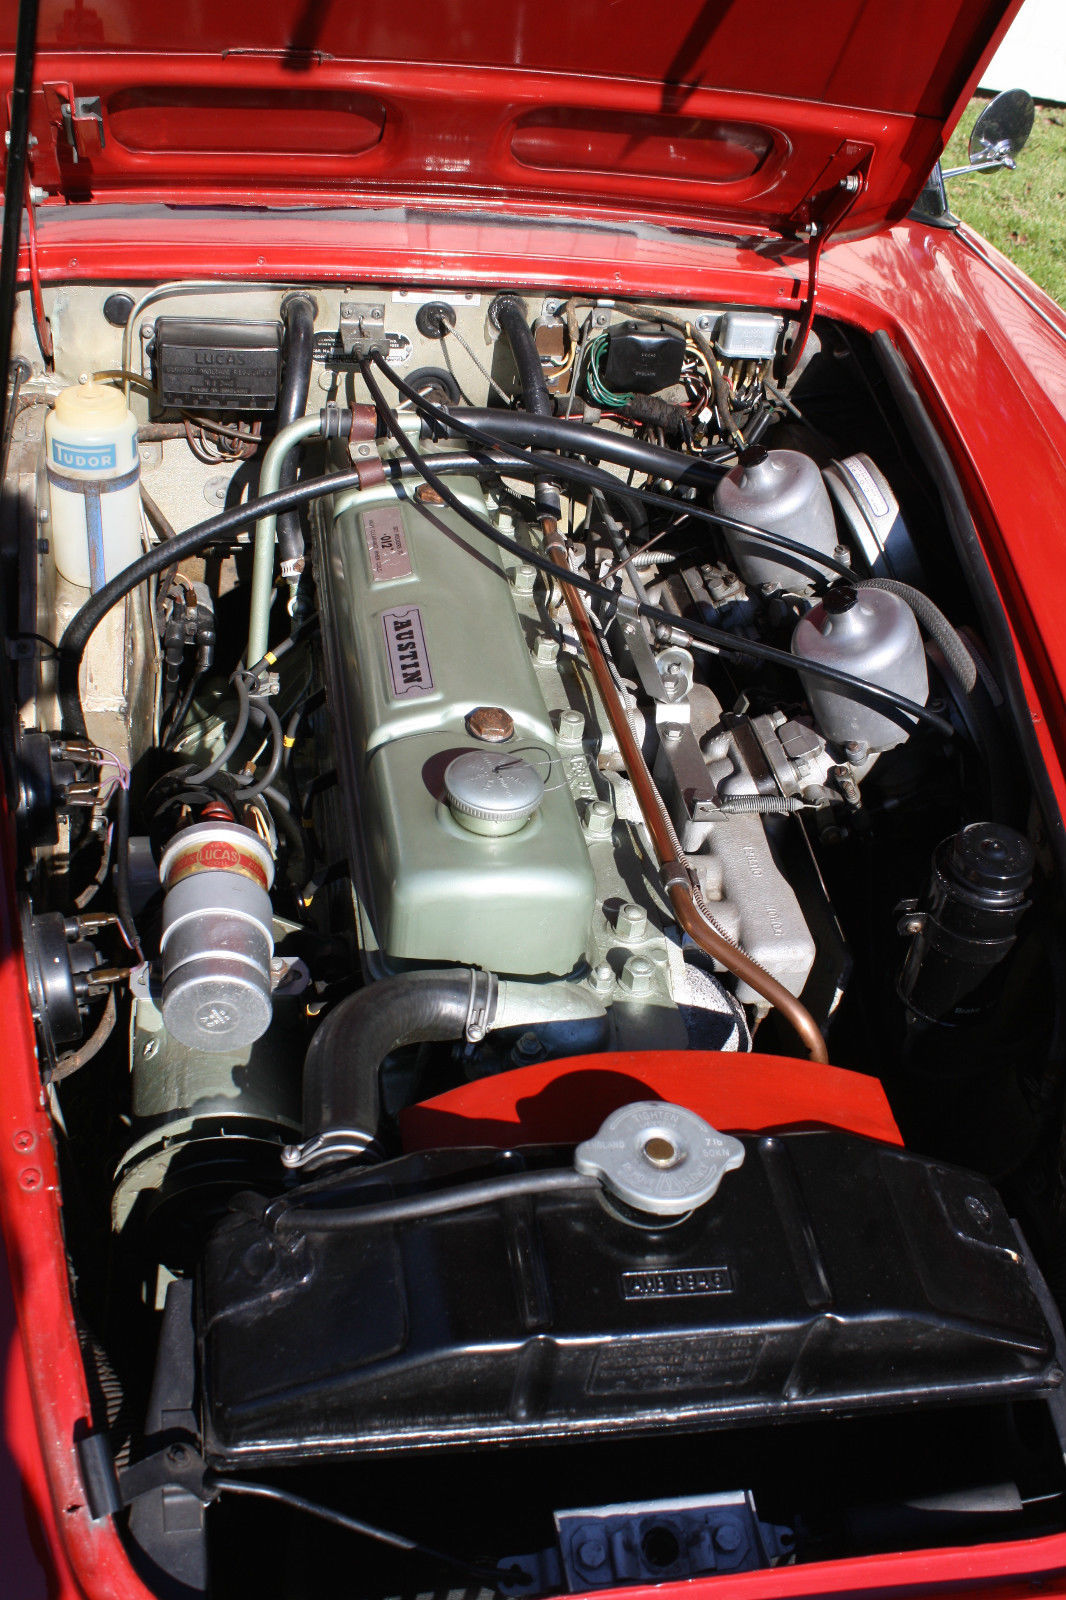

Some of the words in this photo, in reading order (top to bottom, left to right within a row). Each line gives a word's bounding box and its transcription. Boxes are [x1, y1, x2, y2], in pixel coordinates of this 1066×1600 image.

[195, 353, 246, 365] LUCAS
[55, 443, 112, 467] TUDOR
[393, 619, 423, 684] AUSTIN
[199, 849, 238, 862] LUCAS
[631, 1111, 680, 1122] TIGHTEN
